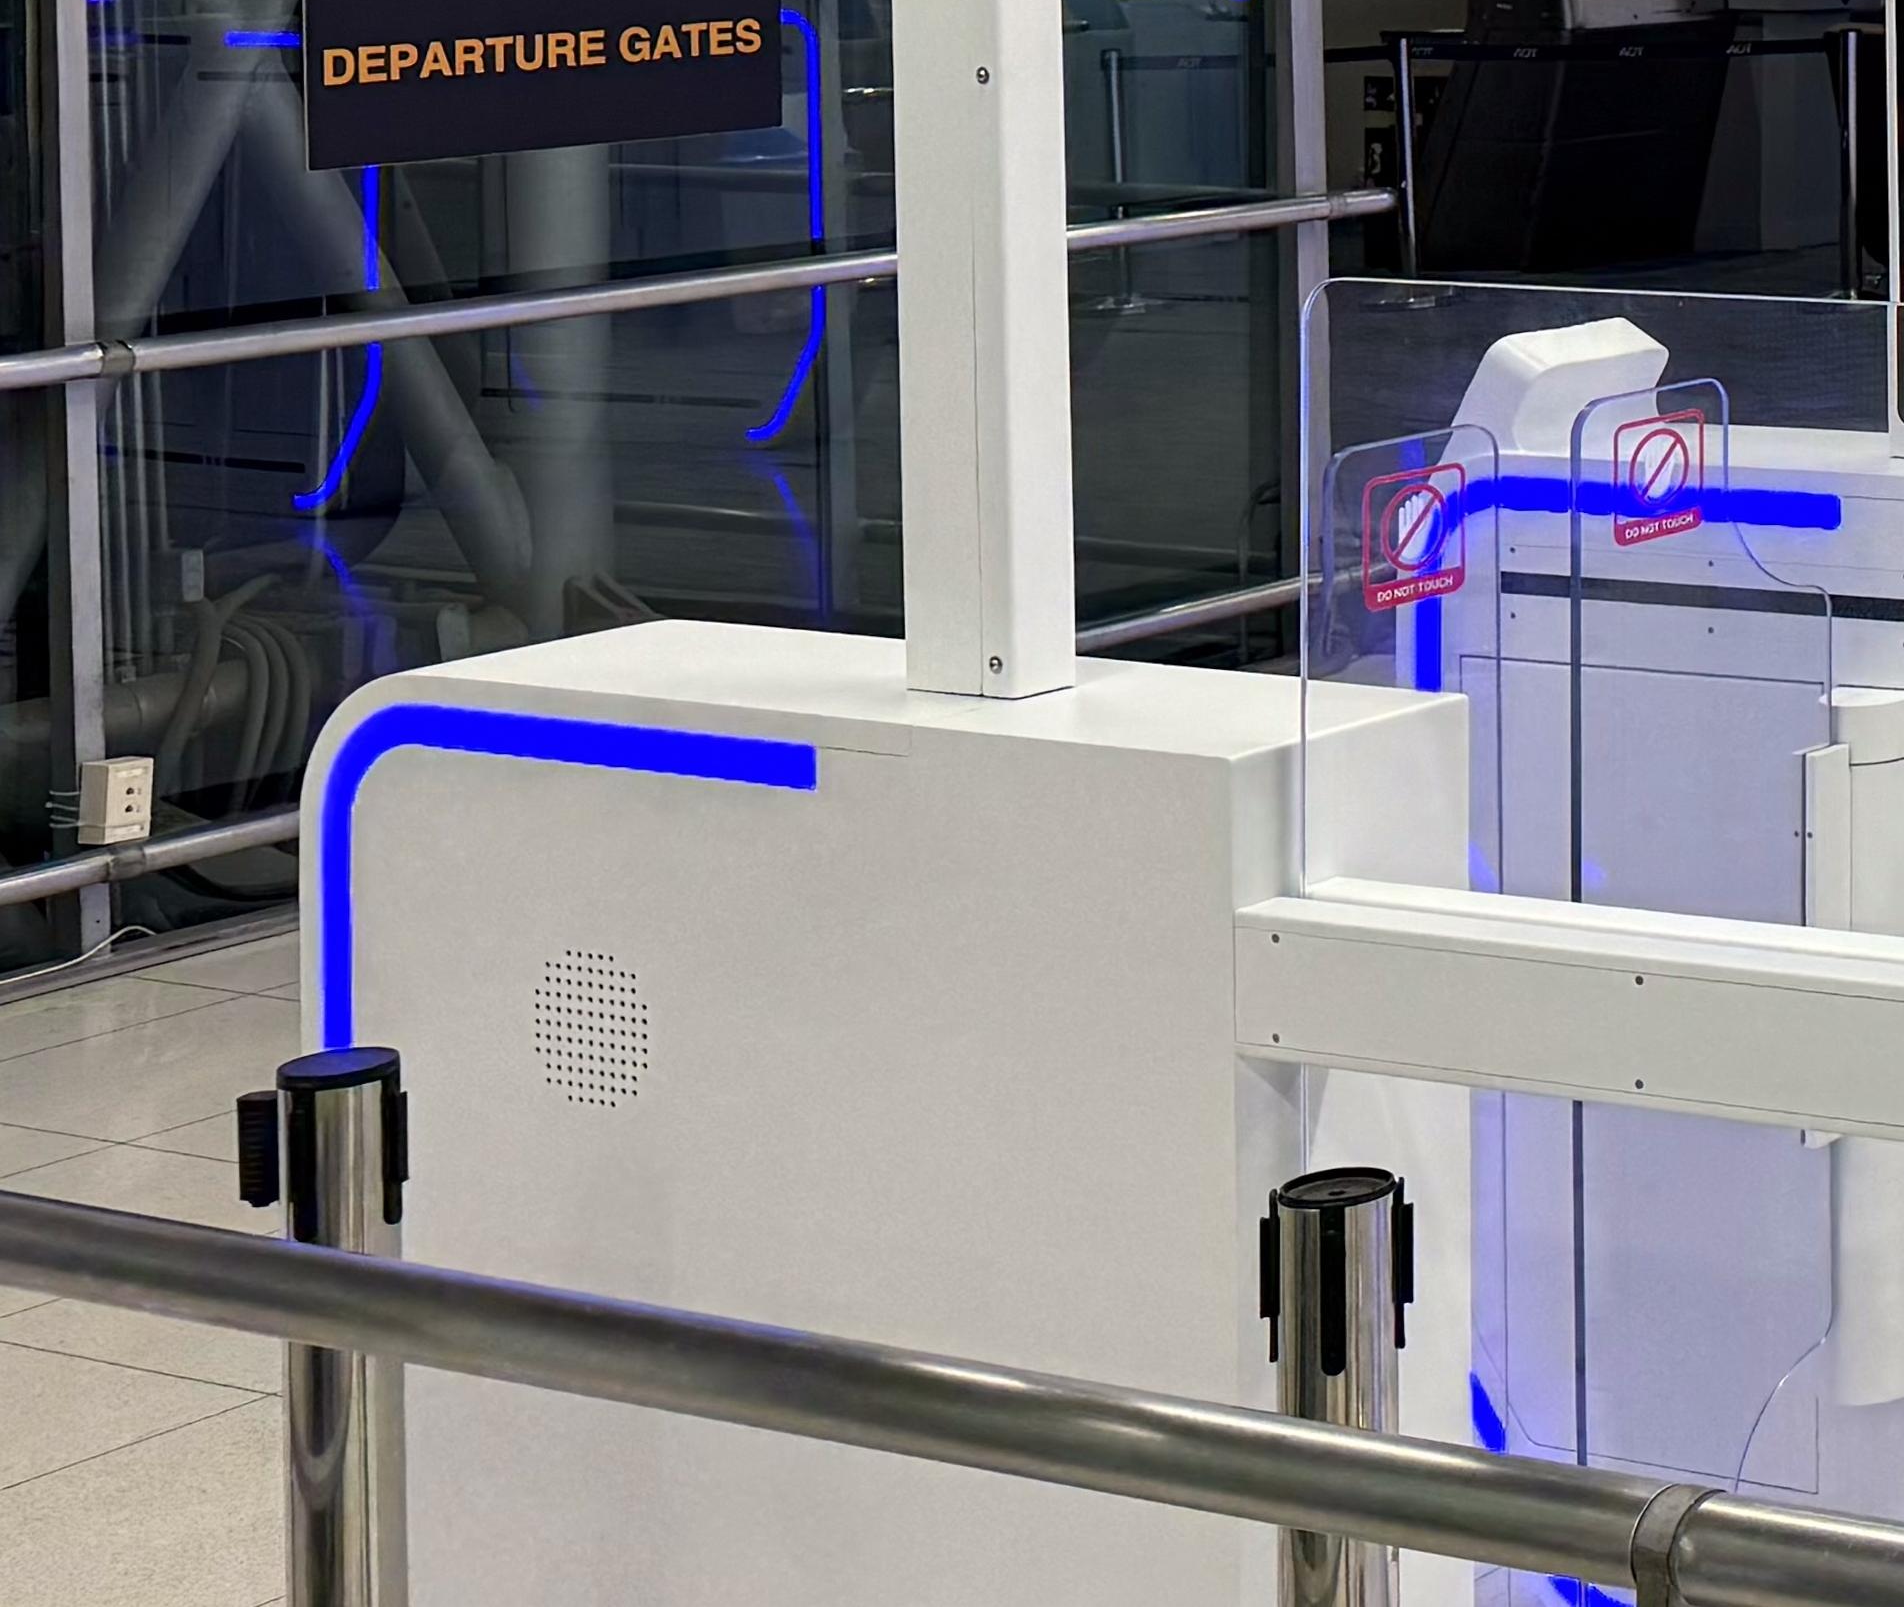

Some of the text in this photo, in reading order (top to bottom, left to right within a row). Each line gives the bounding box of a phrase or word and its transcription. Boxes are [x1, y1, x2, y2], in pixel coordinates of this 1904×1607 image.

[322, 18, 762, 86] DEPARTURE GATES
[1624, 526, 1640, 540] DO
[1661, 511, 1695, 531] TOUCH
[1376, 573, 1454, 603] DO NOT TOUCH
